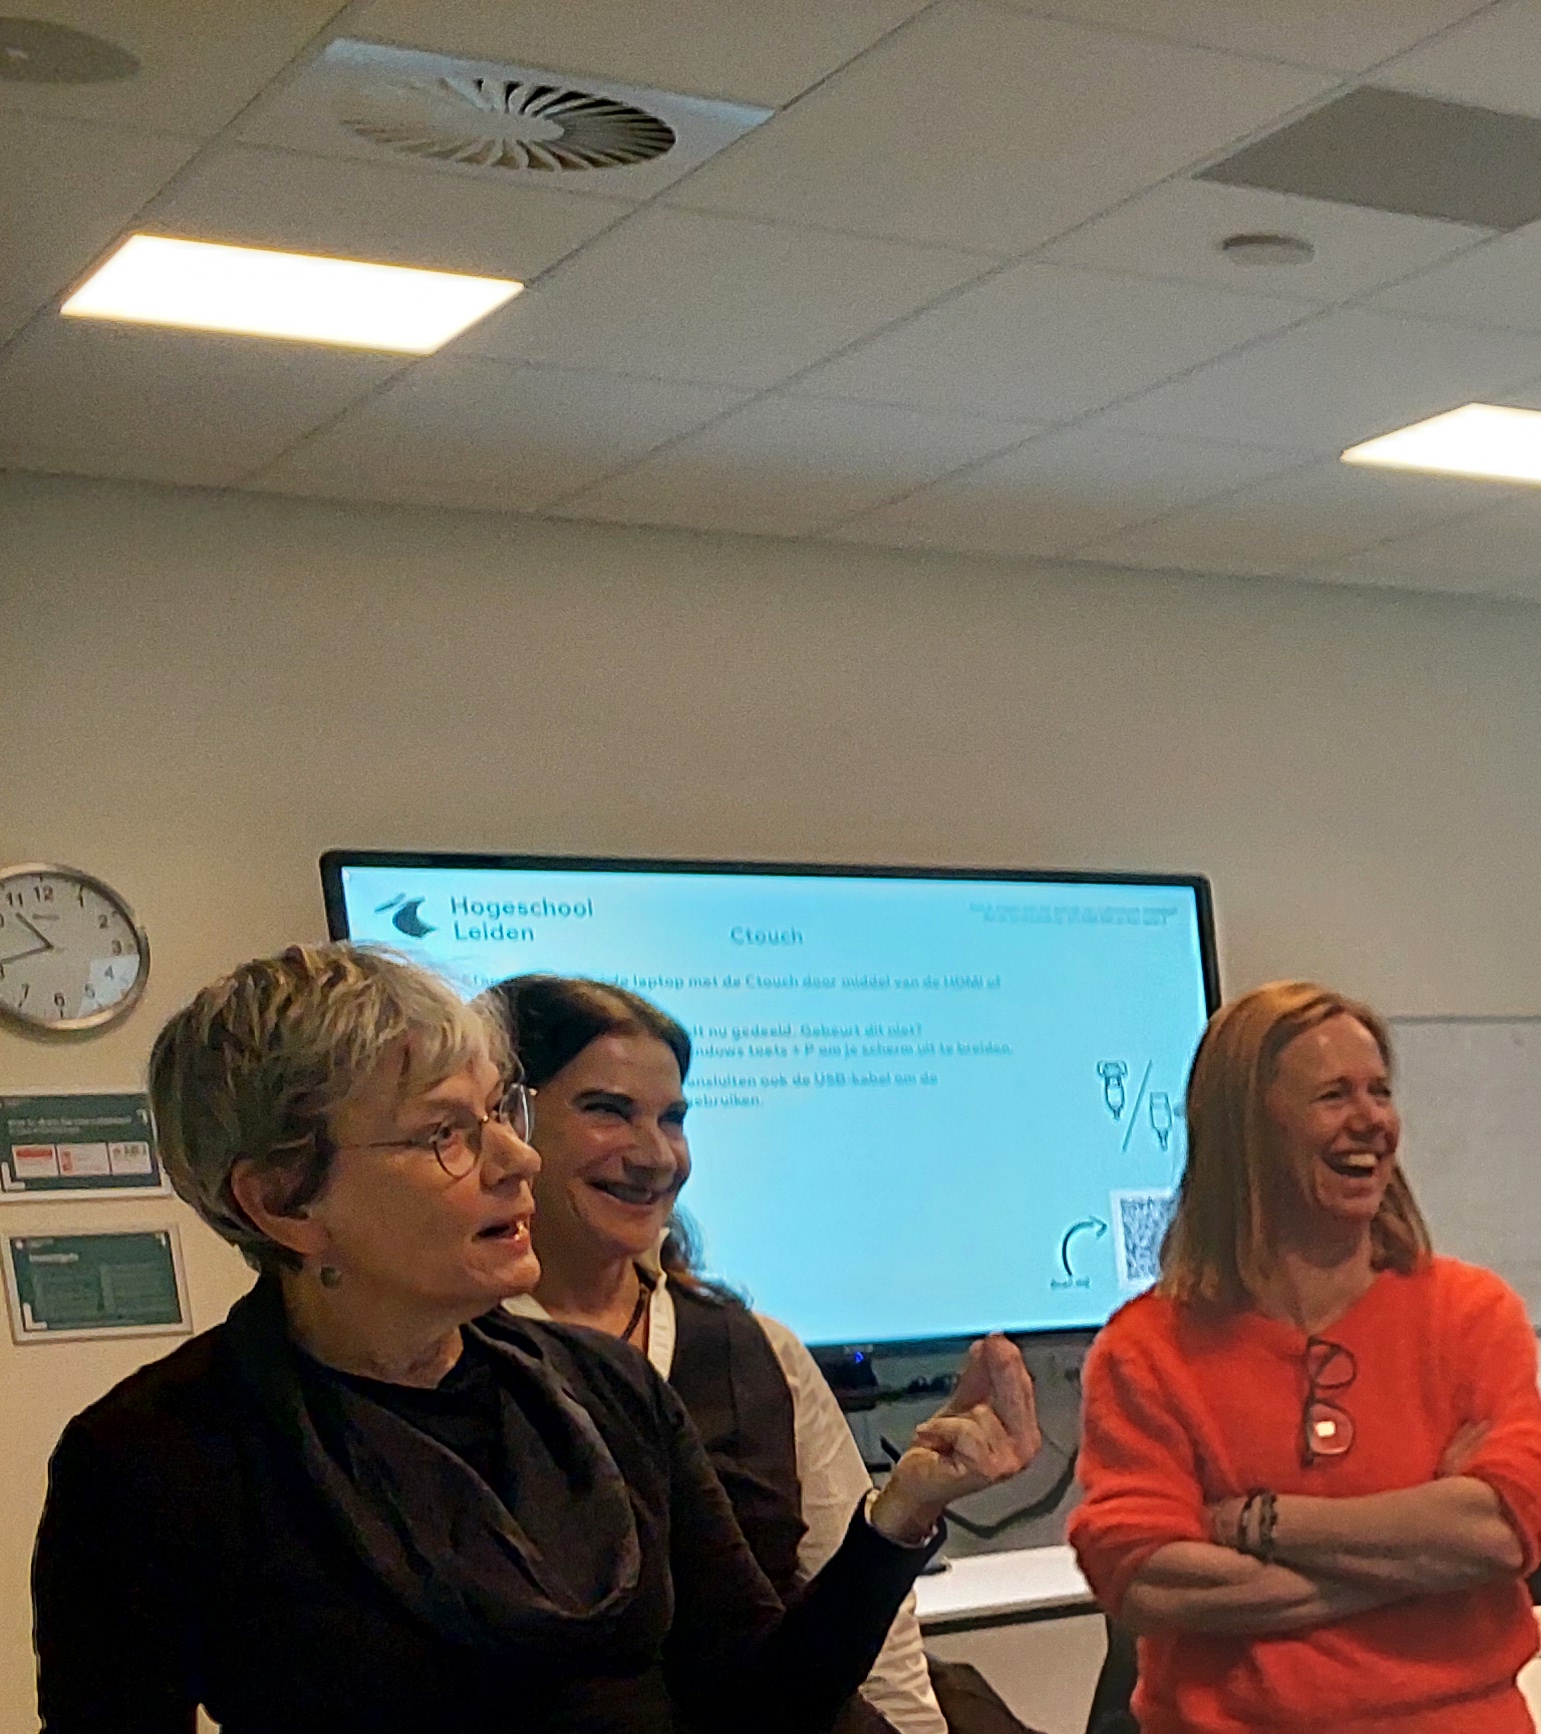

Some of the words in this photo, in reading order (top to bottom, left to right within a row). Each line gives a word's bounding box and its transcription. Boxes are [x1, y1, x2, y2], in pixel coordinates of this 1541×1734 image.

[450, 896, 593, 919] Hogeschool
[453, 920, 535, 942] Leiden
[730, 926, 804, 946] Ctouch
[633, 973, 684, 990] laptop
[688, 974, 718, 988] met
[722, 973, 740, 988] de
[745, 973, 798, 988] Ctouch
[802, 974, 836, 988] door
[841, 974, 890, 989] middel
[894, 977, 919, 989] van
[922, 974, 940, 988] de
[800, 1023, 860, 1037] Gebeurt
[864, 1023, 884, 1037] dit
[792, 1073, 810, 1088] de
[919, 1072, 938, 1087] de
